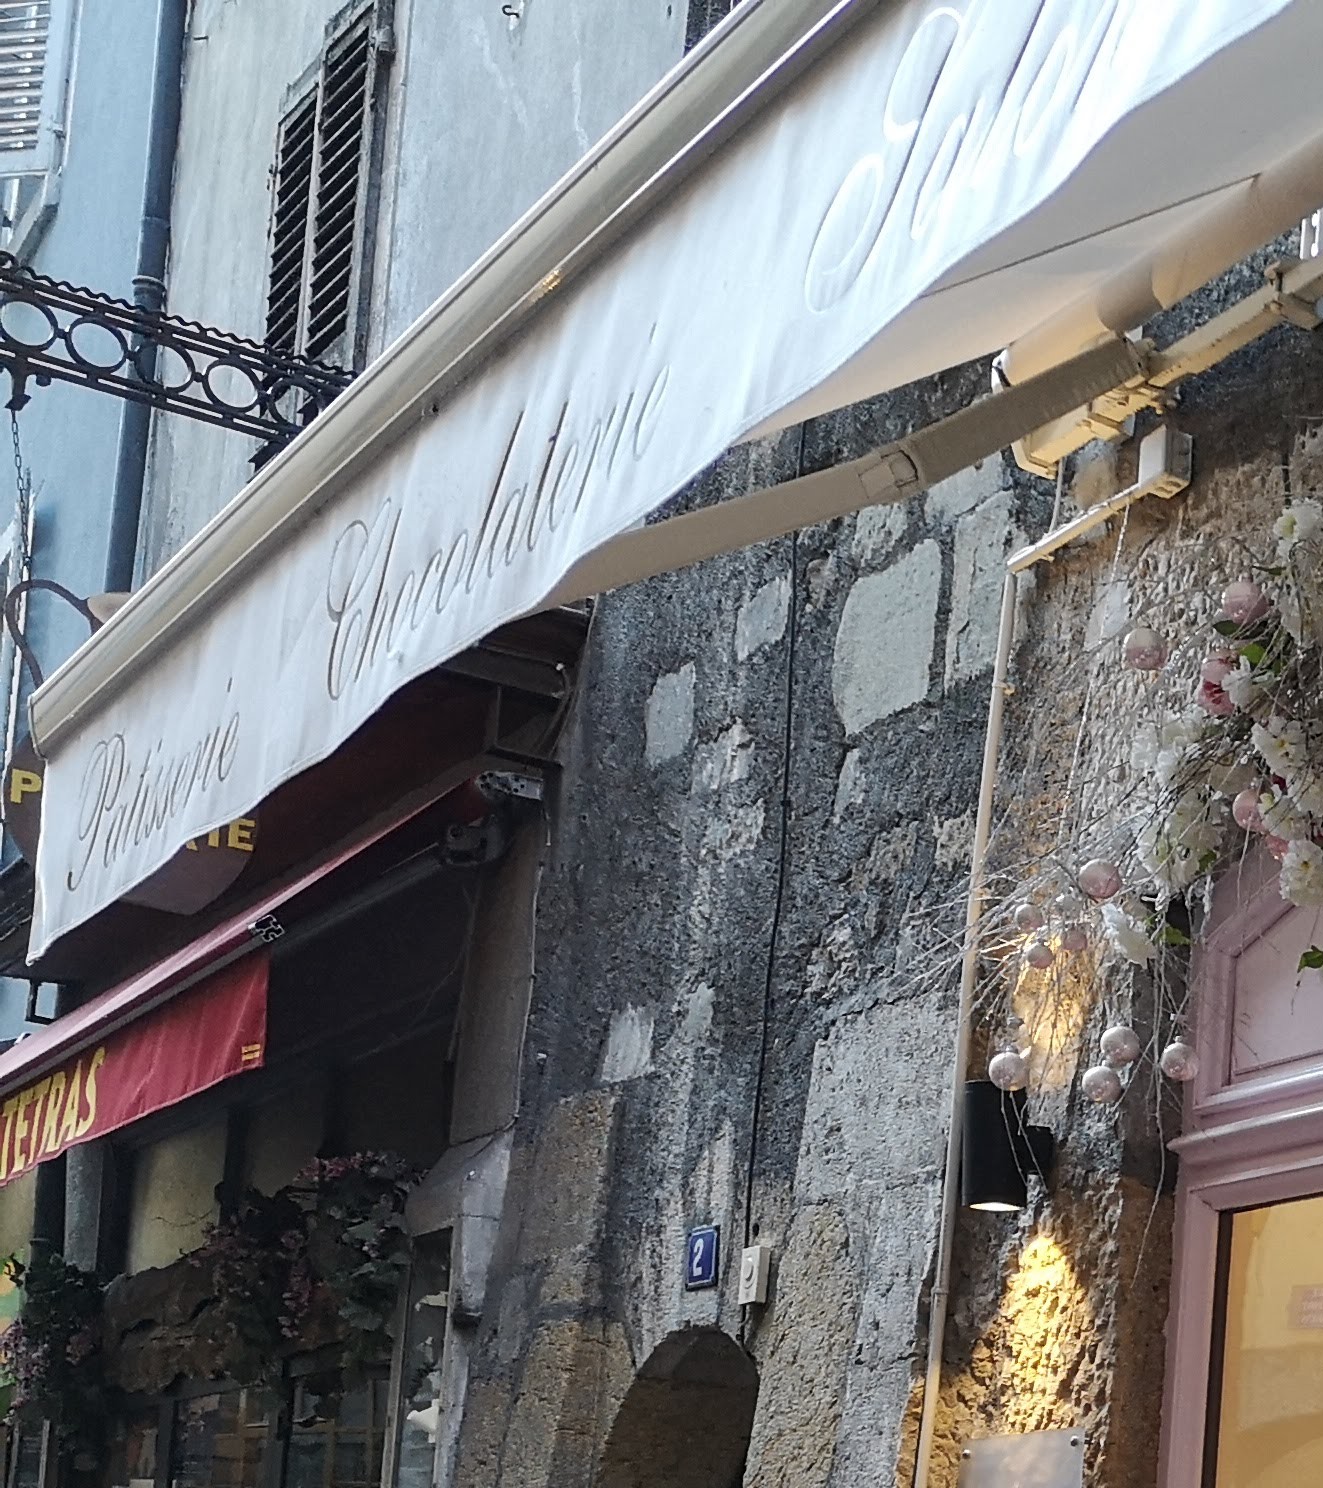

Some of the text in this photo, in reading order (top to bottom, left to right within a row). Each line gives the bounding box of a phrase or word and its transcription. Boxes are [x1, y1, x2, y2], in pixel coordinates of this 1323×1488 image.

[326, 320, 670, 701] Chocolaterie
[0, 1046, 106, 1180] TETRAS
[693, 1238, 704, 1277] 2
